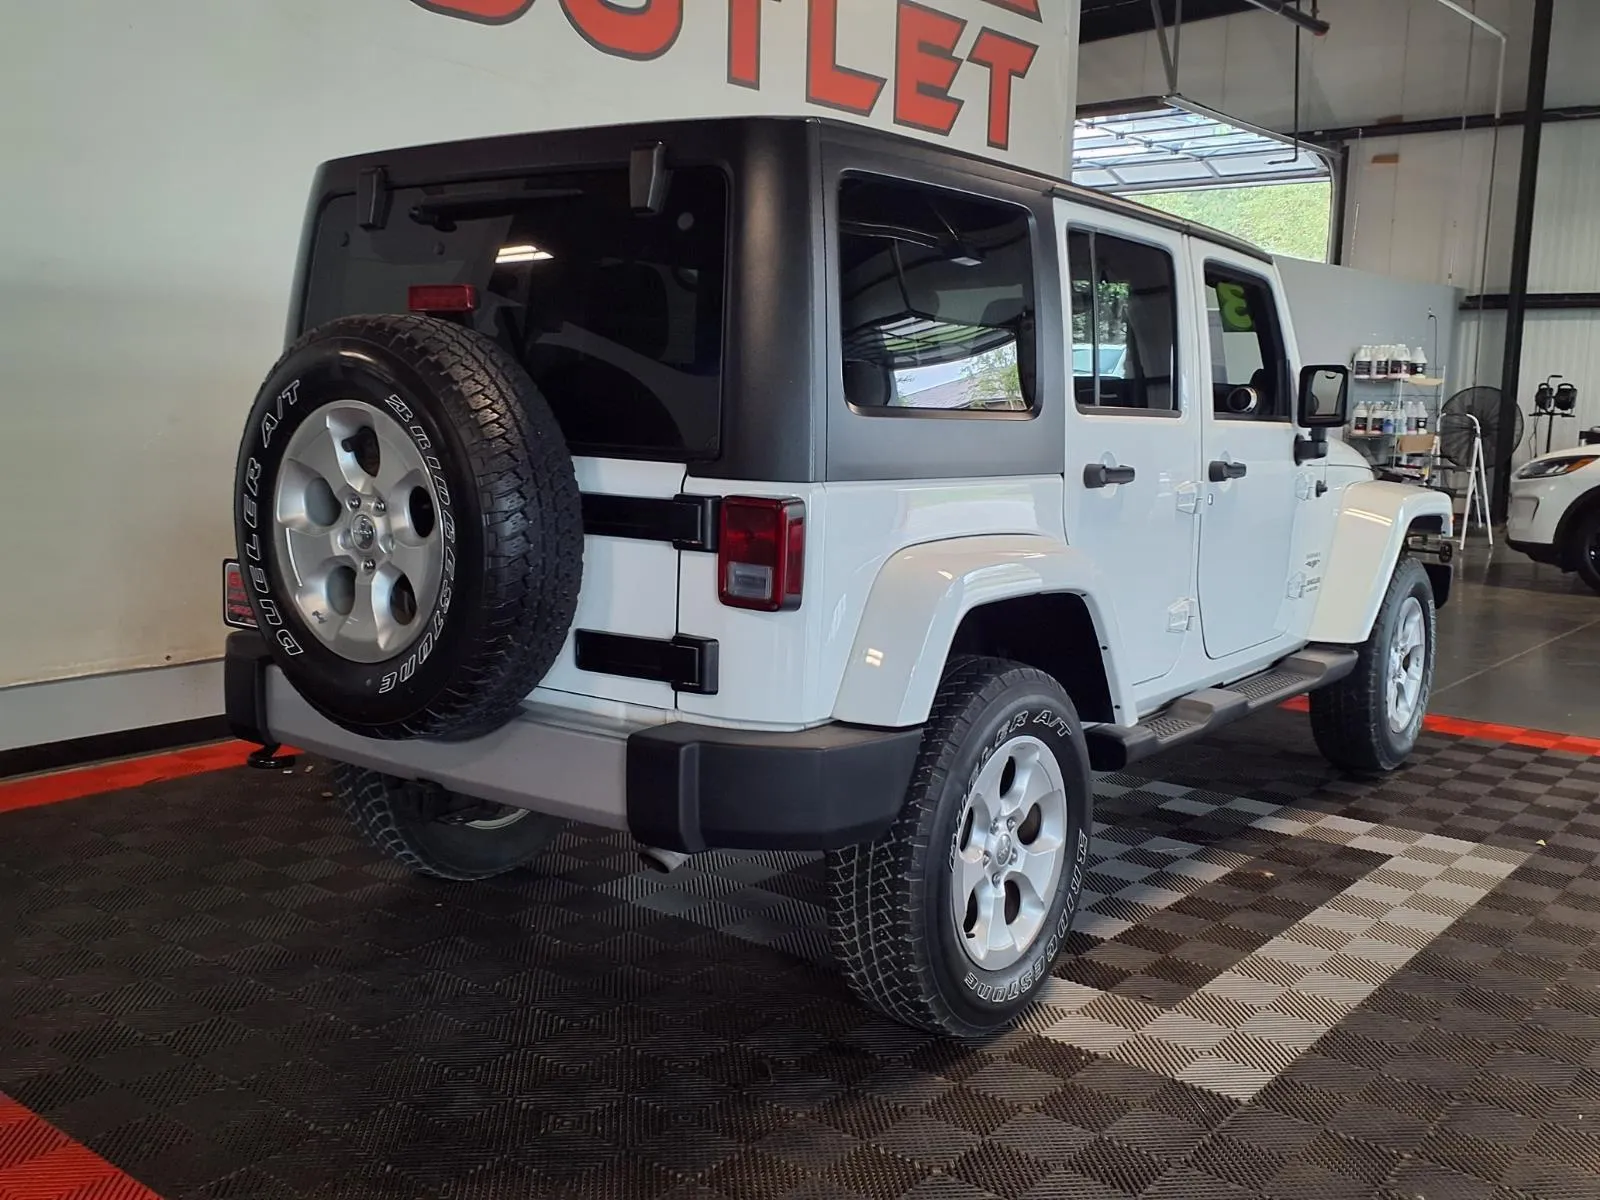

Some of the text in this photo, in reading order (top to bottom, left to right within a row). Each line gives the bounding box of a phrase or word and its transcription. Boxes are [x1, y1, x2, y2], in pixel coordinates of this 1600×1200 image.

[409, 0, 1040, 151] TLET
[243, 379, 304, 656] DUELER A/T
[379, 394, 456, 694] BRIDGESTONE
[1033, 709, 1072, 737] A/T
[964, 828, 1088, 1003] BRIDGESTONE
